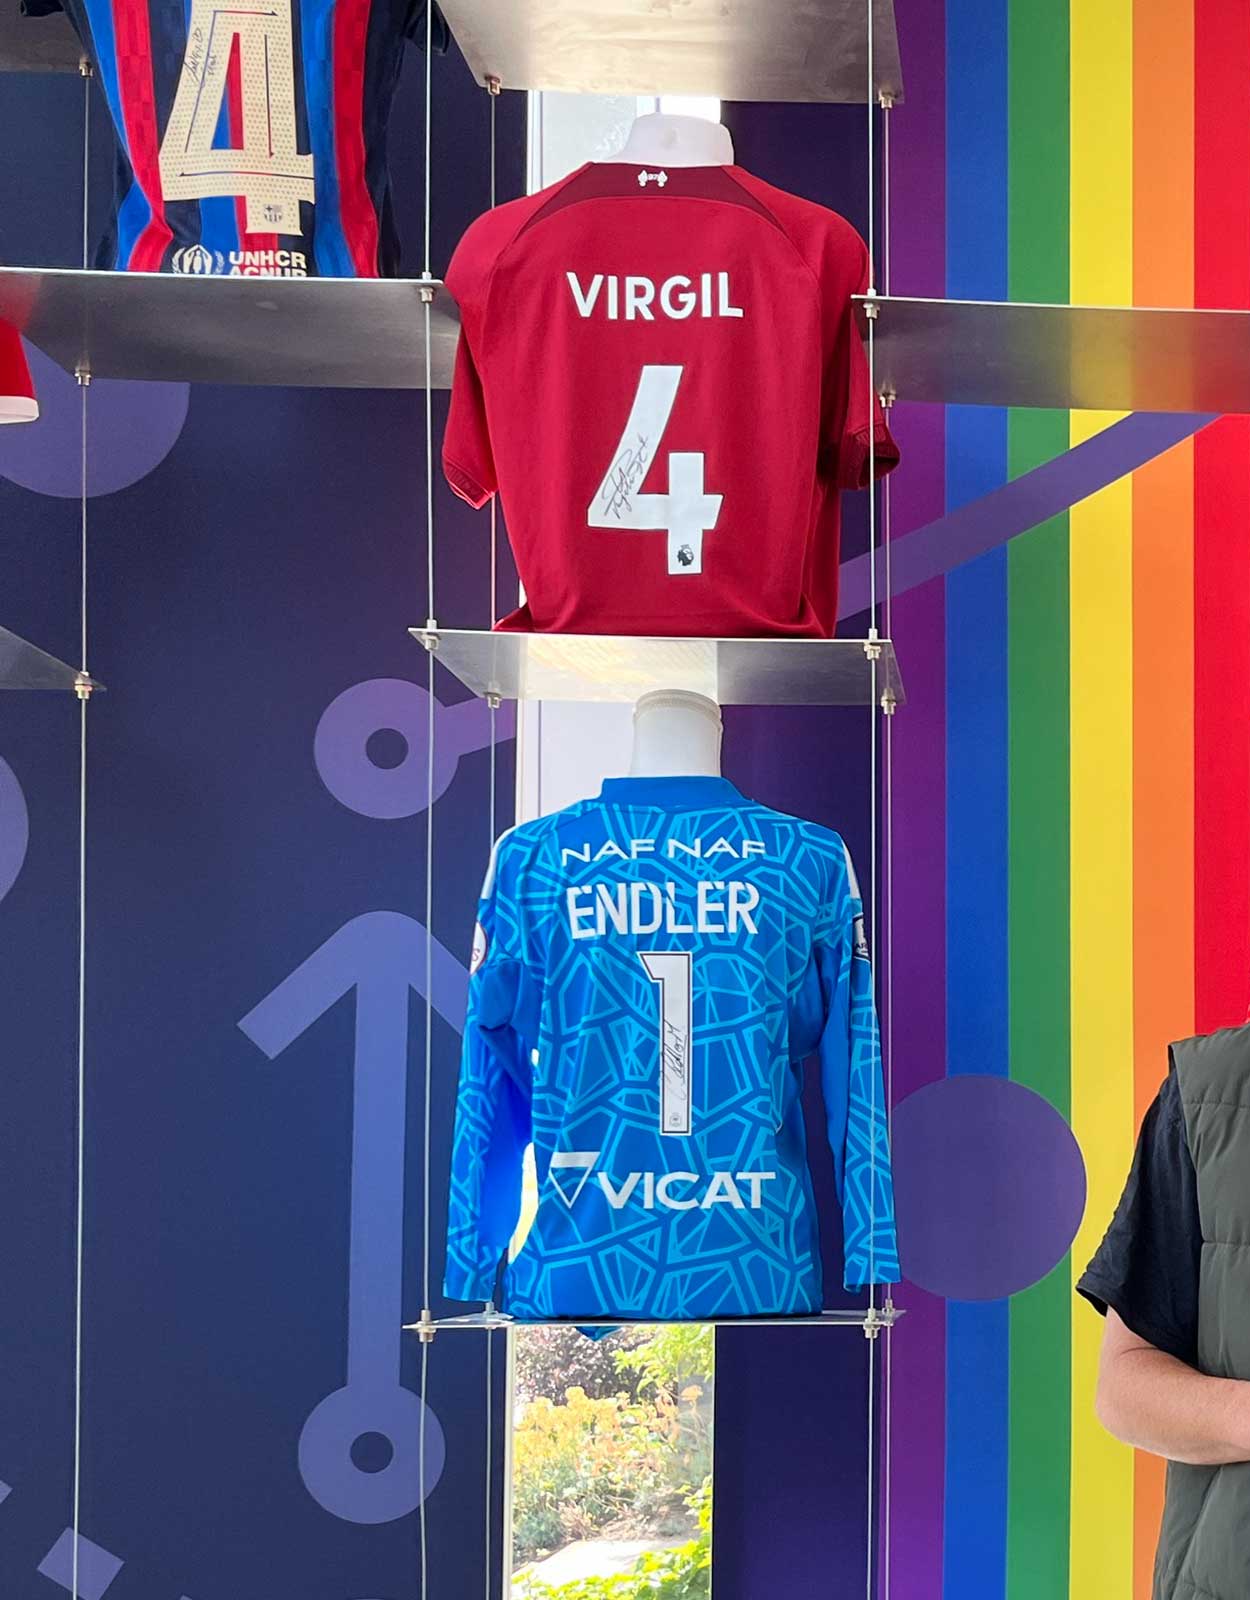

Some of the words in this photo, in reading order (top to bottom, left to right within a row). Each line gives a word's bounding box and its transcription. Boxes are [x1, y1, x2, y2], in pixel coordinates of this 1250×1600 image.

[158, 0, 314, 236] 4
[228, 250, 307, 268] UNHCR
[567, 272, 743, 321] VIRGIL
[588, 364, 723, 575] 4
[562, 839, 656, 866] NAF
[667, 837, 766, 860] NAF
[566, 881, 759, 939] ENDLER
[638, 951, 693, 1136] 1
[598, 1171, 776, 1209] VICAT
